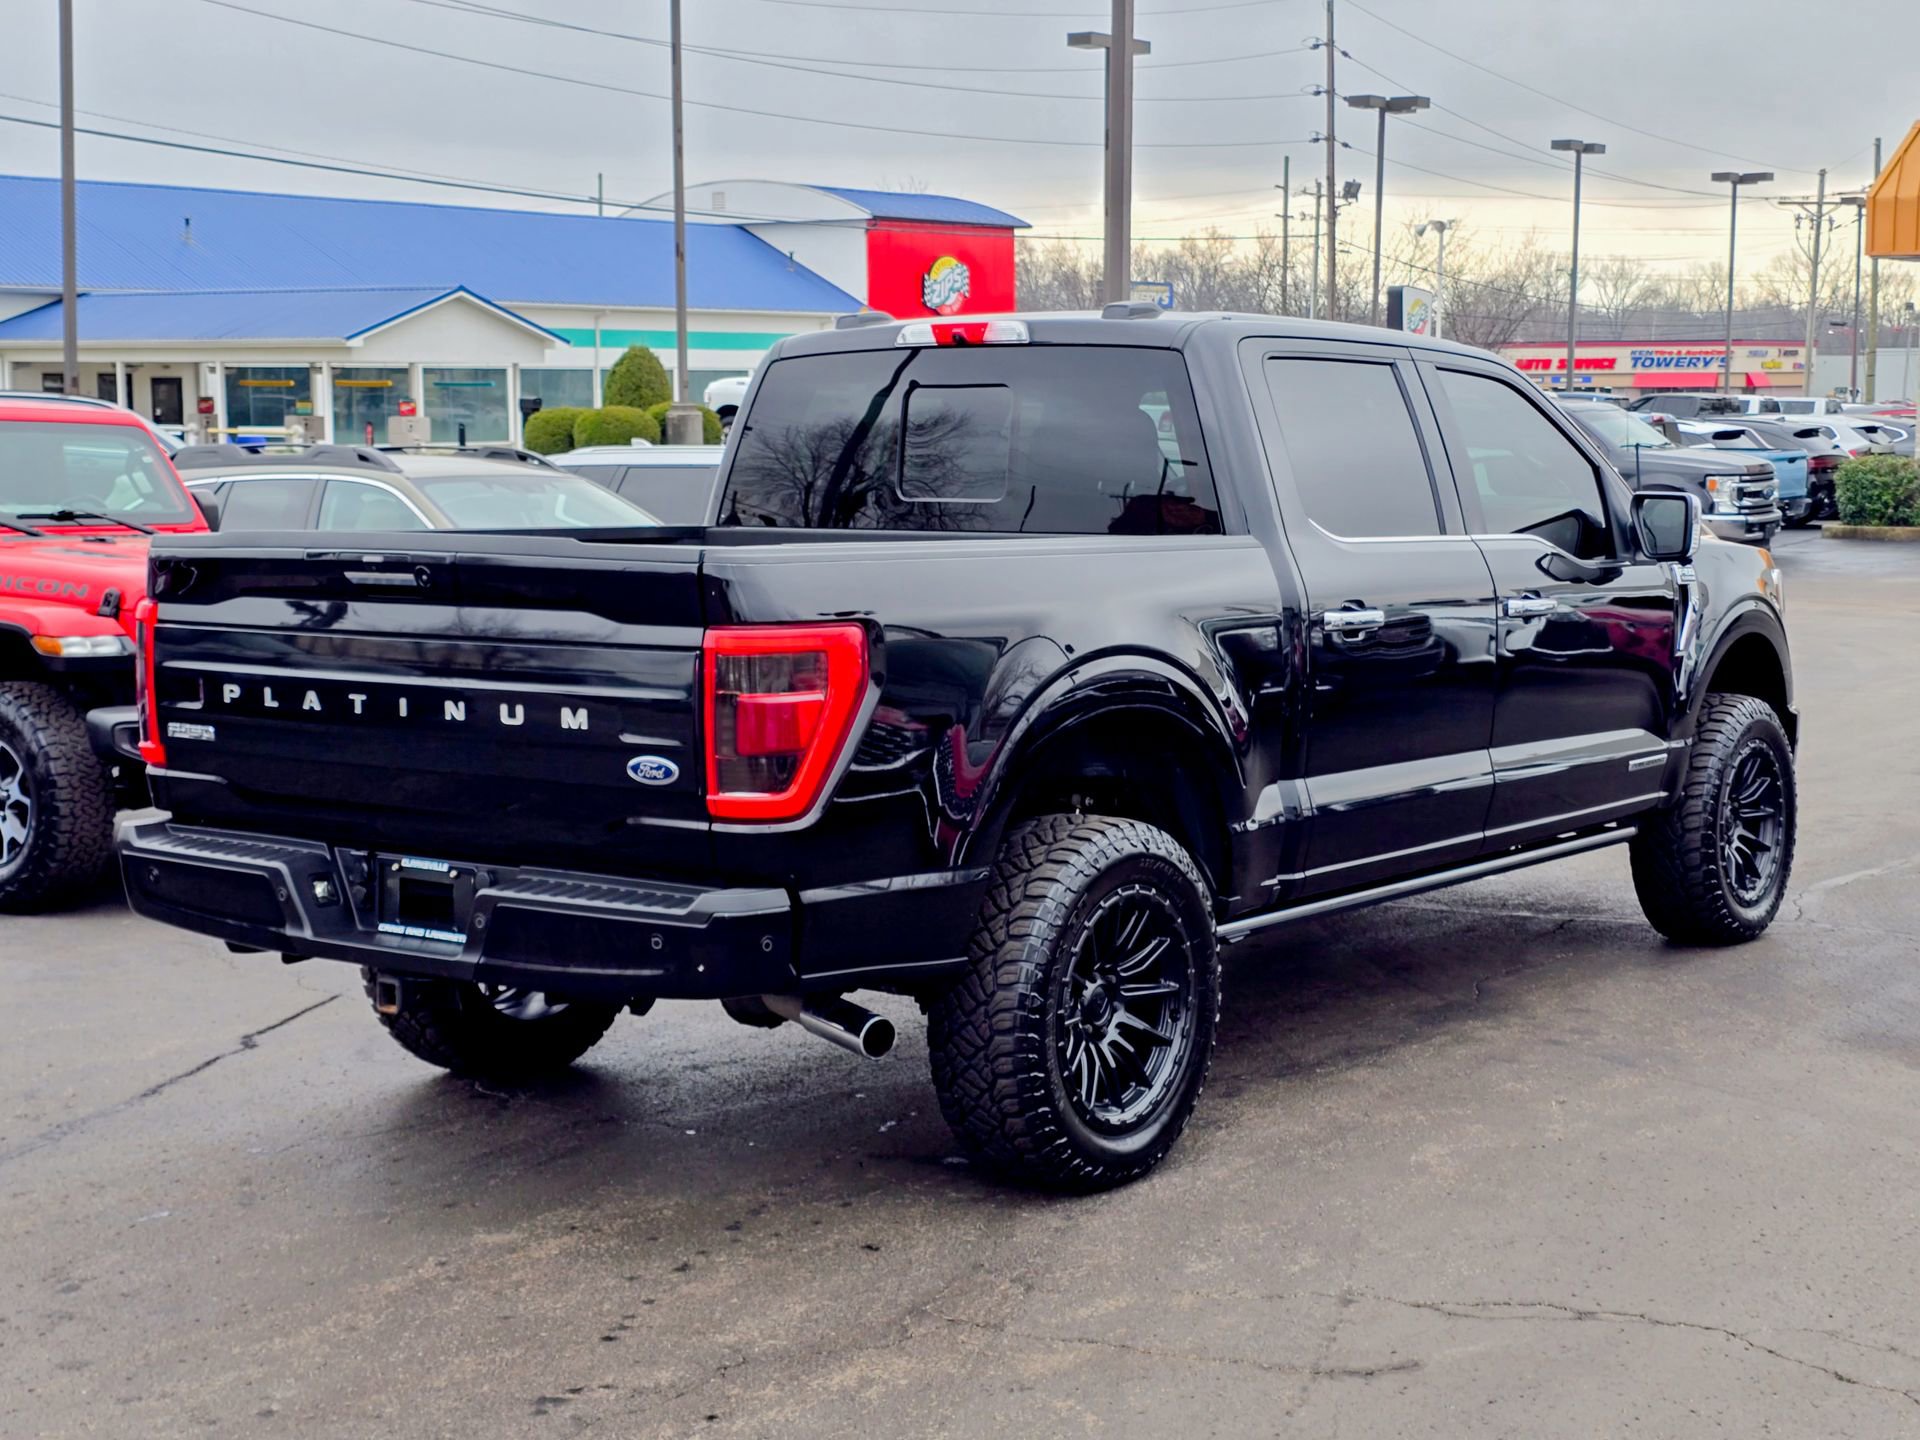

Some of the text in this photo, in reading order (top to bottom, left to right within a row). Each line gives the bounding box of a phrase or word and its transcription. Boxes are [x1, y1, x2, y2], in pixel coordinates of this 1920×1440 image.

[1631, 349, 1654, 357] KEN
[1557, 358, 1617, 370] SRVICE
[1631, 356, 1733, 369] TOWERY'S
[0, 575, 88, 597] ICON
[223, 683, 588, 730] PLATINUM
